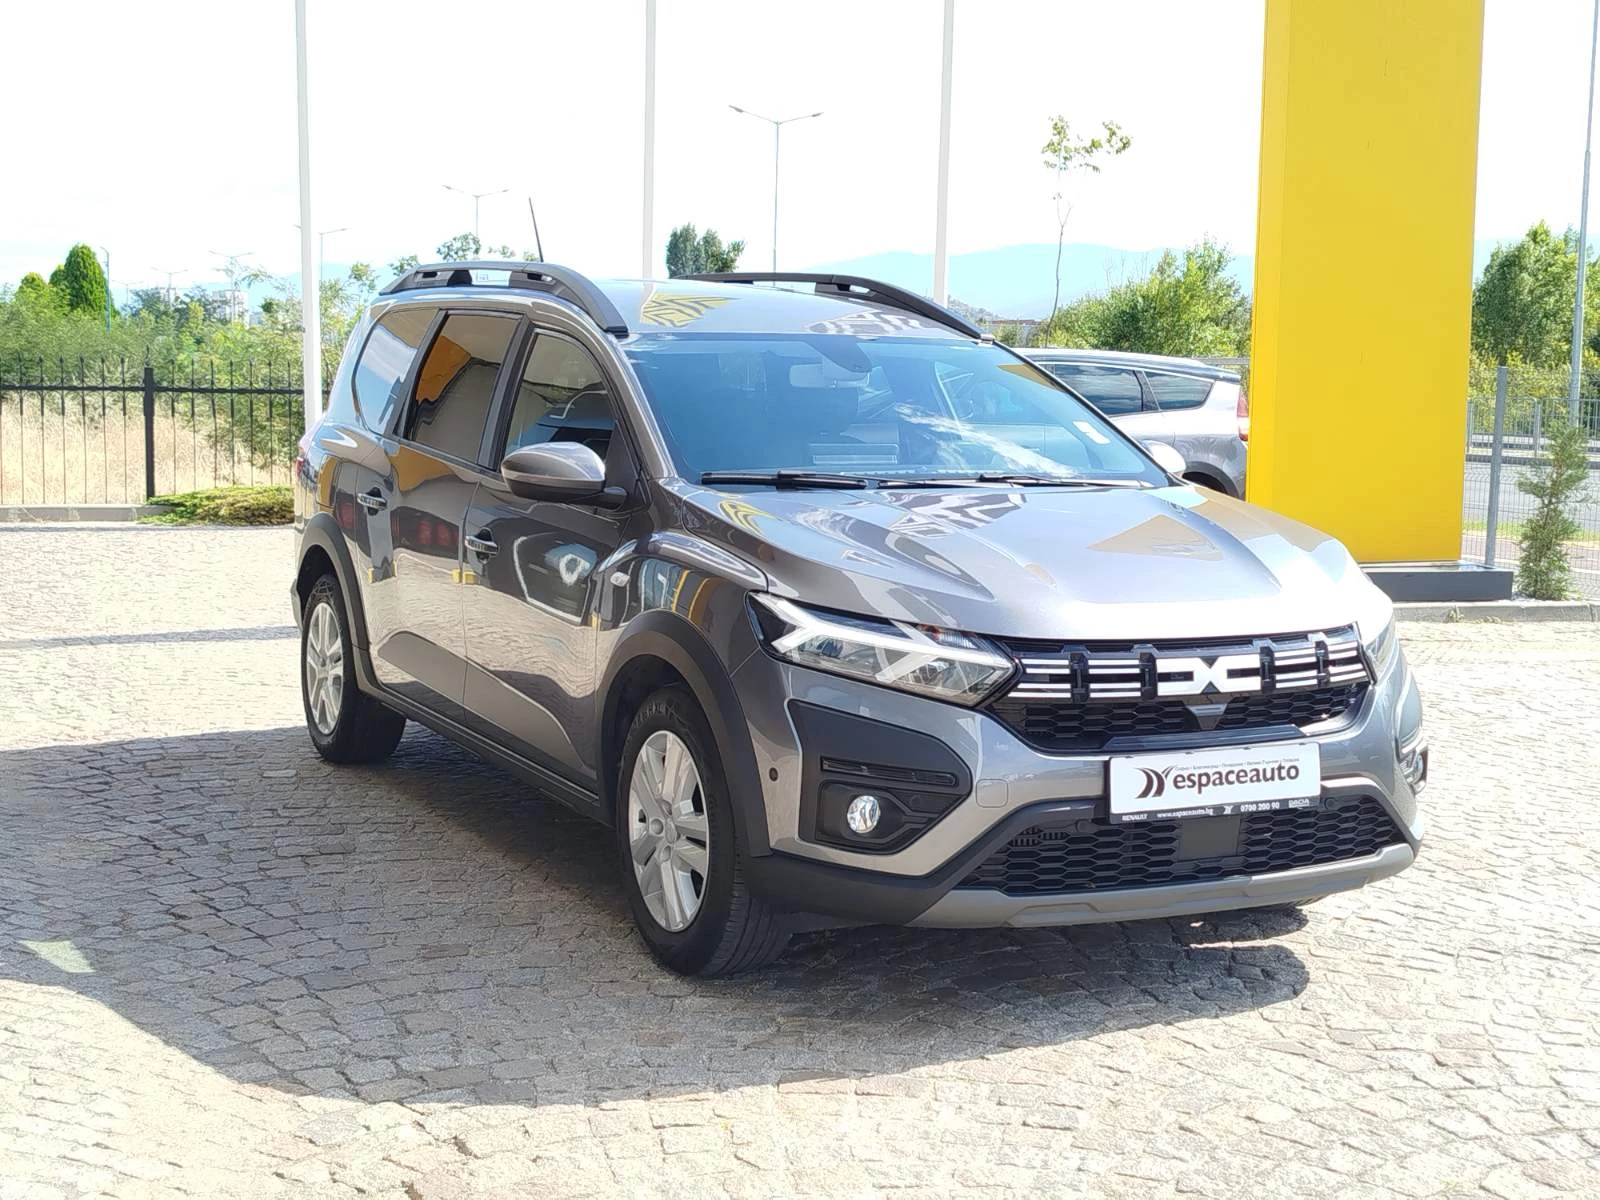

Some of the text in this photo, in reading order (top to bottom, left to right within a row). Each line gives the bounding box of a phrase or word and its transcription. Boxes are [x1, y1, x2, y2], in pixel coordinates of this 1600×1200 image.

[1173, 762, 1300, 794] espaceauto
[1121, 813, 1148, 821] RENAULT
[1257, 803, 1271, 811] 200
[1271, 802, 1280, 810] 90
